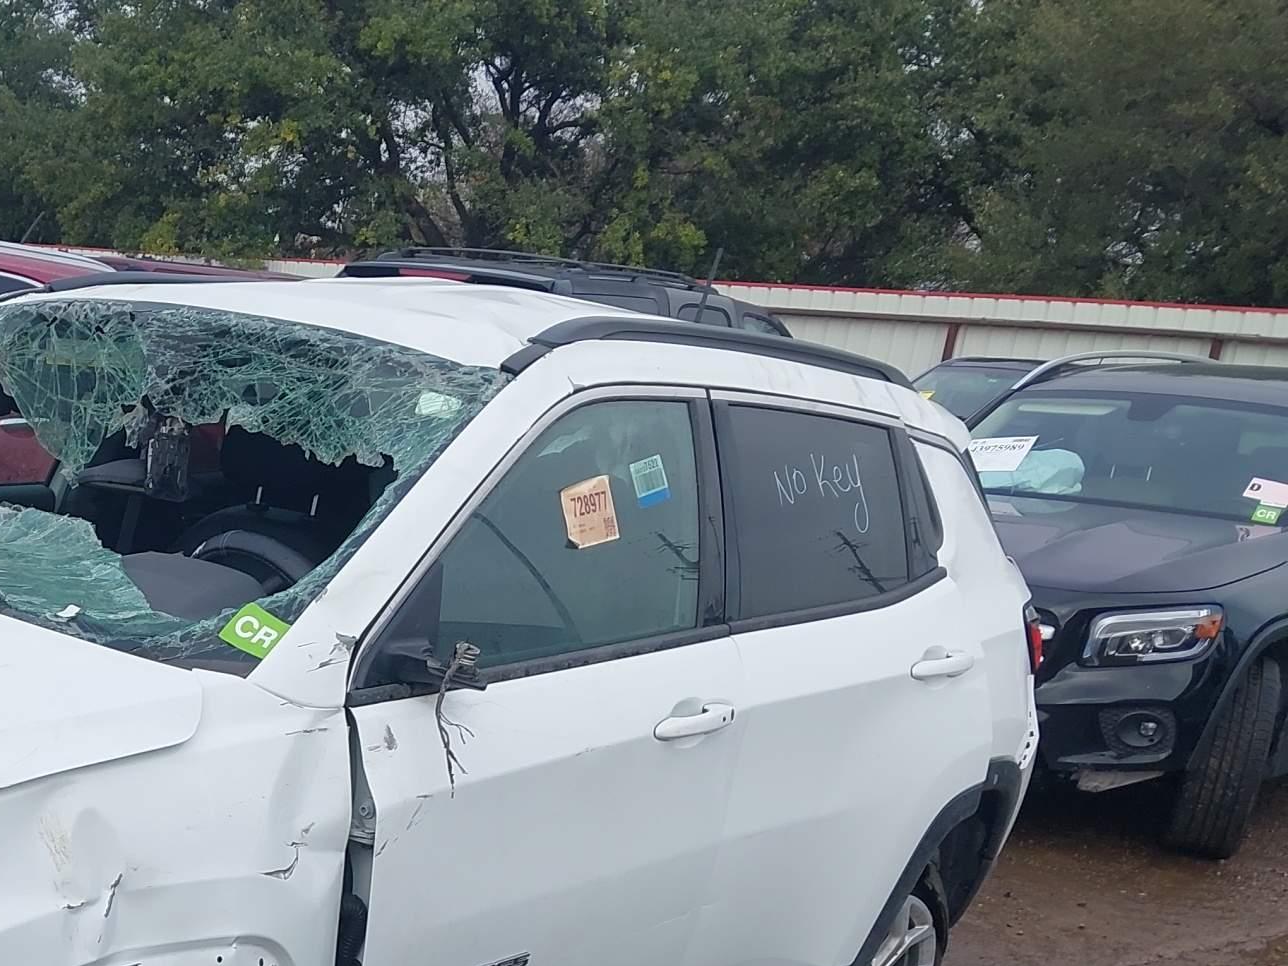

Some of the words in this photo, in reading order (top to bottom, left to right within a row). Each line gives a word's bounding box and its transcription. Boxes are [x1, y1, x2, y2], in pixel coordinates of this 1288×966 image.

[810, 453, 869, 533] Key
[1249, 483, 1262, 492] D
[570, 490, 608, 519] 728977
[1256, 509, 1277, 520] CR
[235, 615, 279, 649] CR
